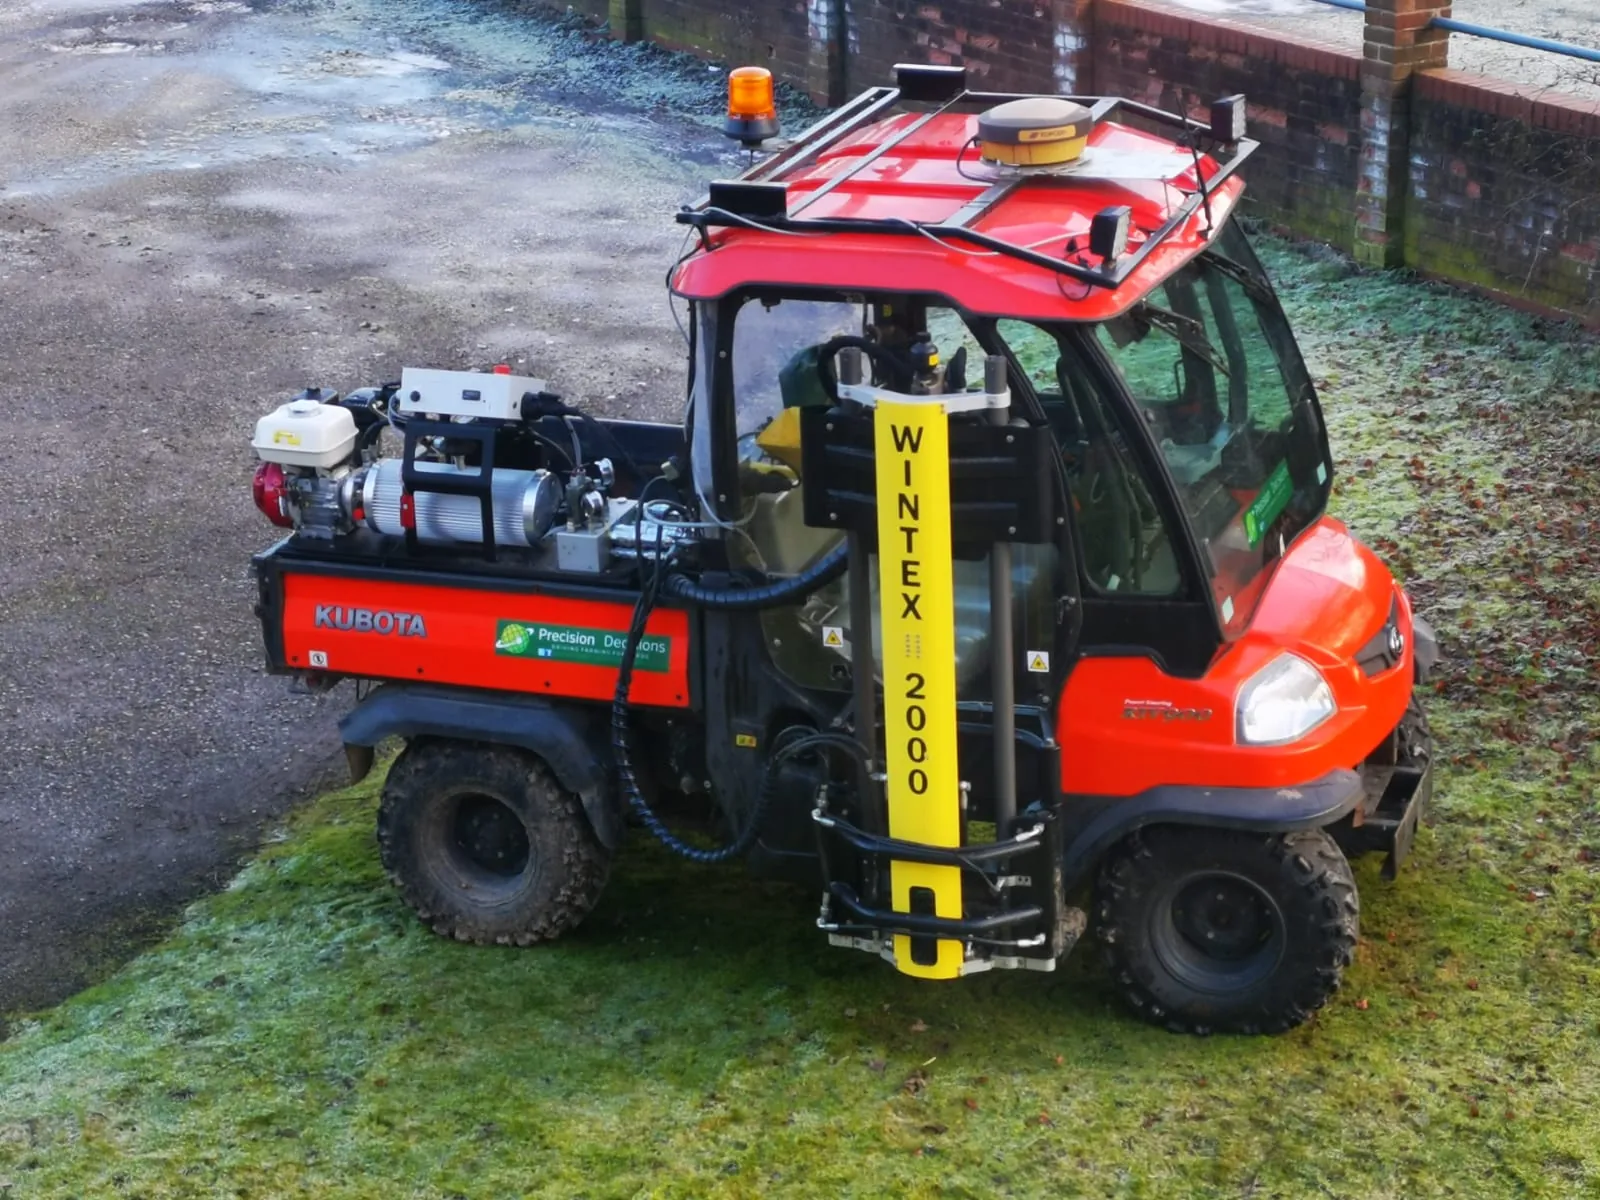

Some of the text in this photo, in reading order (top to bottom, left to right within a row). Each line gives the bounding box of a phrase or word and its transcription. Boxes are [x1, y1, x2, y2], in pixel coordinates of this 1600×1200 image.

[890, 424, 924, 621] WINTEX
[314, 604, 427, 637] KUBOTA
[538, 628, 595, 646] Precision
[905, 672, 928, 795] 2000
